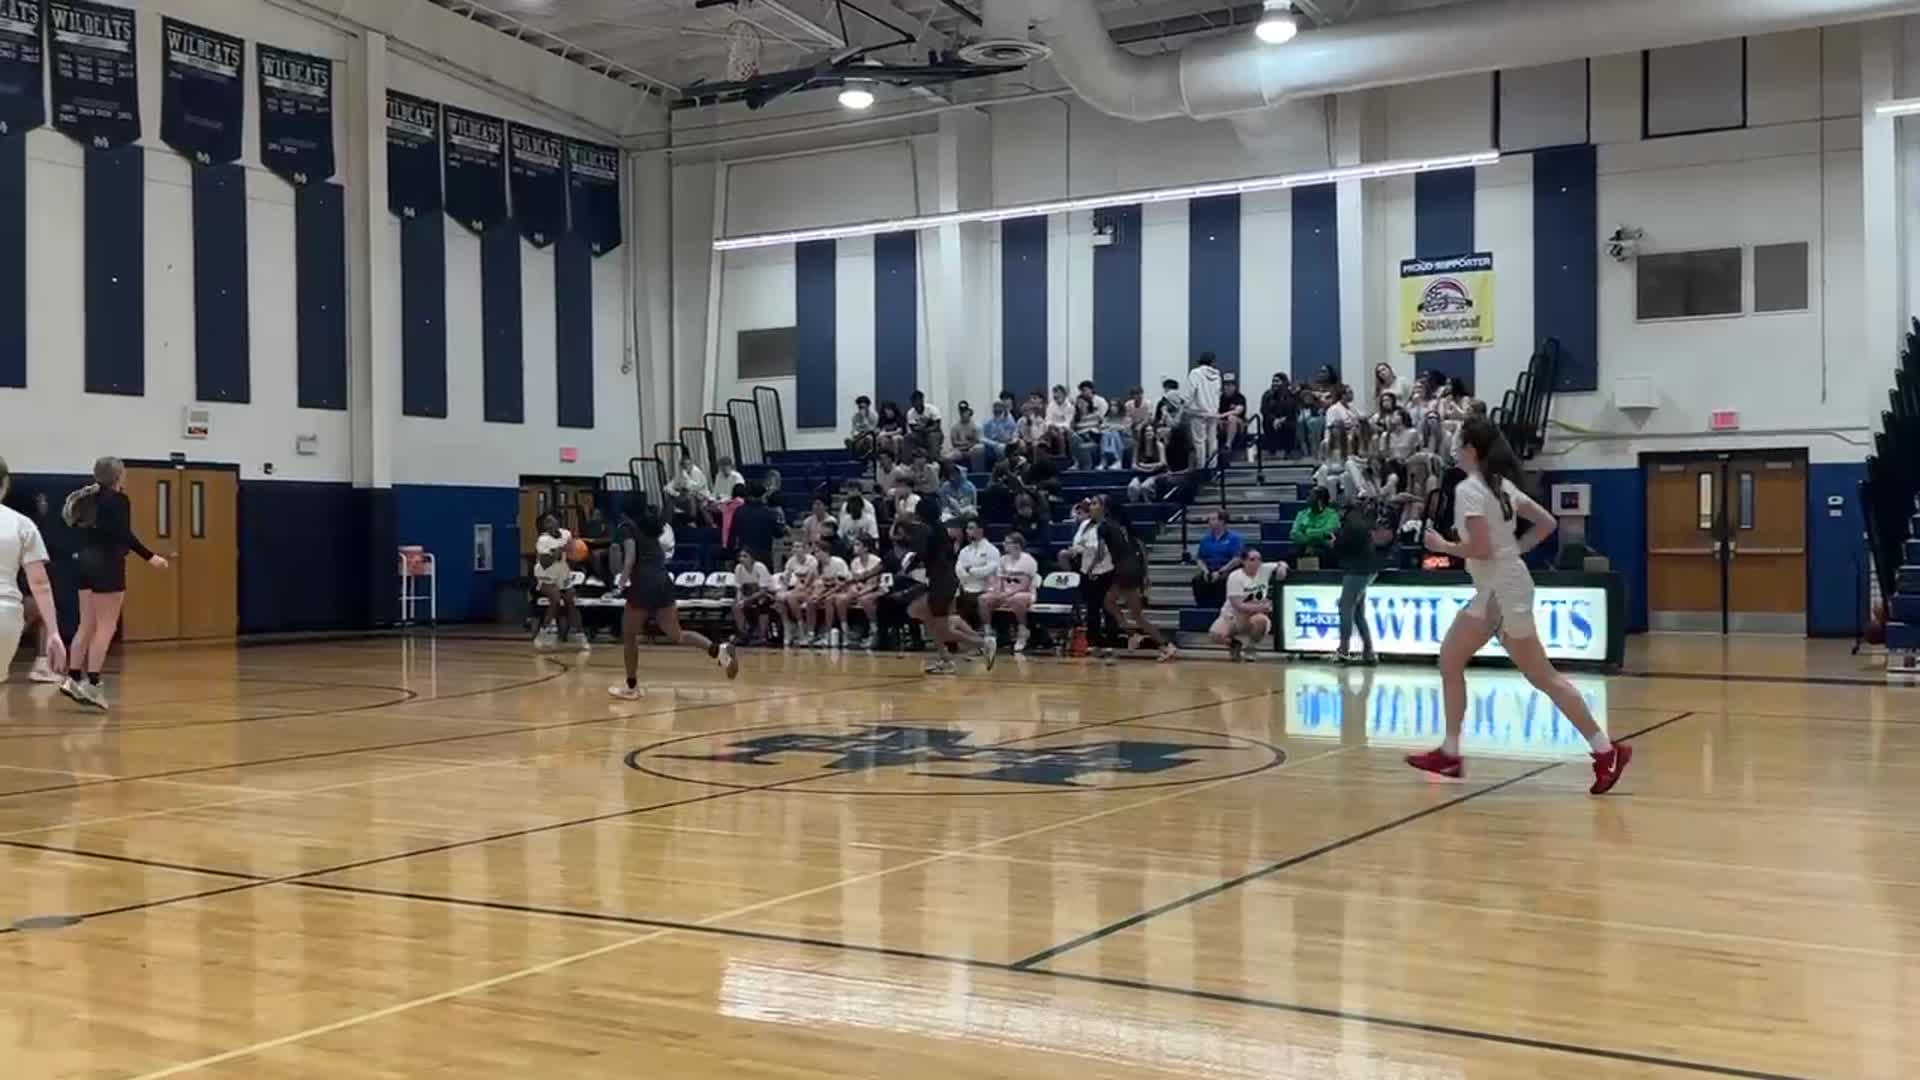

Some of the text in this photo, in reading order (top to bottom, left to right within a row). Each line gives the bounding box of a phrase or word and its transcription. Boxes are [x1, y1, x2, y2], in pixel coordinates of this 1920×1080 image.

[51, 8, 131, 40] WILDCATS
[167, 30, 241, 66] WILDCATS
[262, 56, 329, 86] WILDCATS
[447, 115, 503, 143] WILDCATS
[511, 132, 562, 159] WILDCATS
[568, 145, 617, 172] WILDCATS
[1403, 257, 1490, 273] PROUD SUPPORTER
[1367, 597, 1593, 650] WILTS
